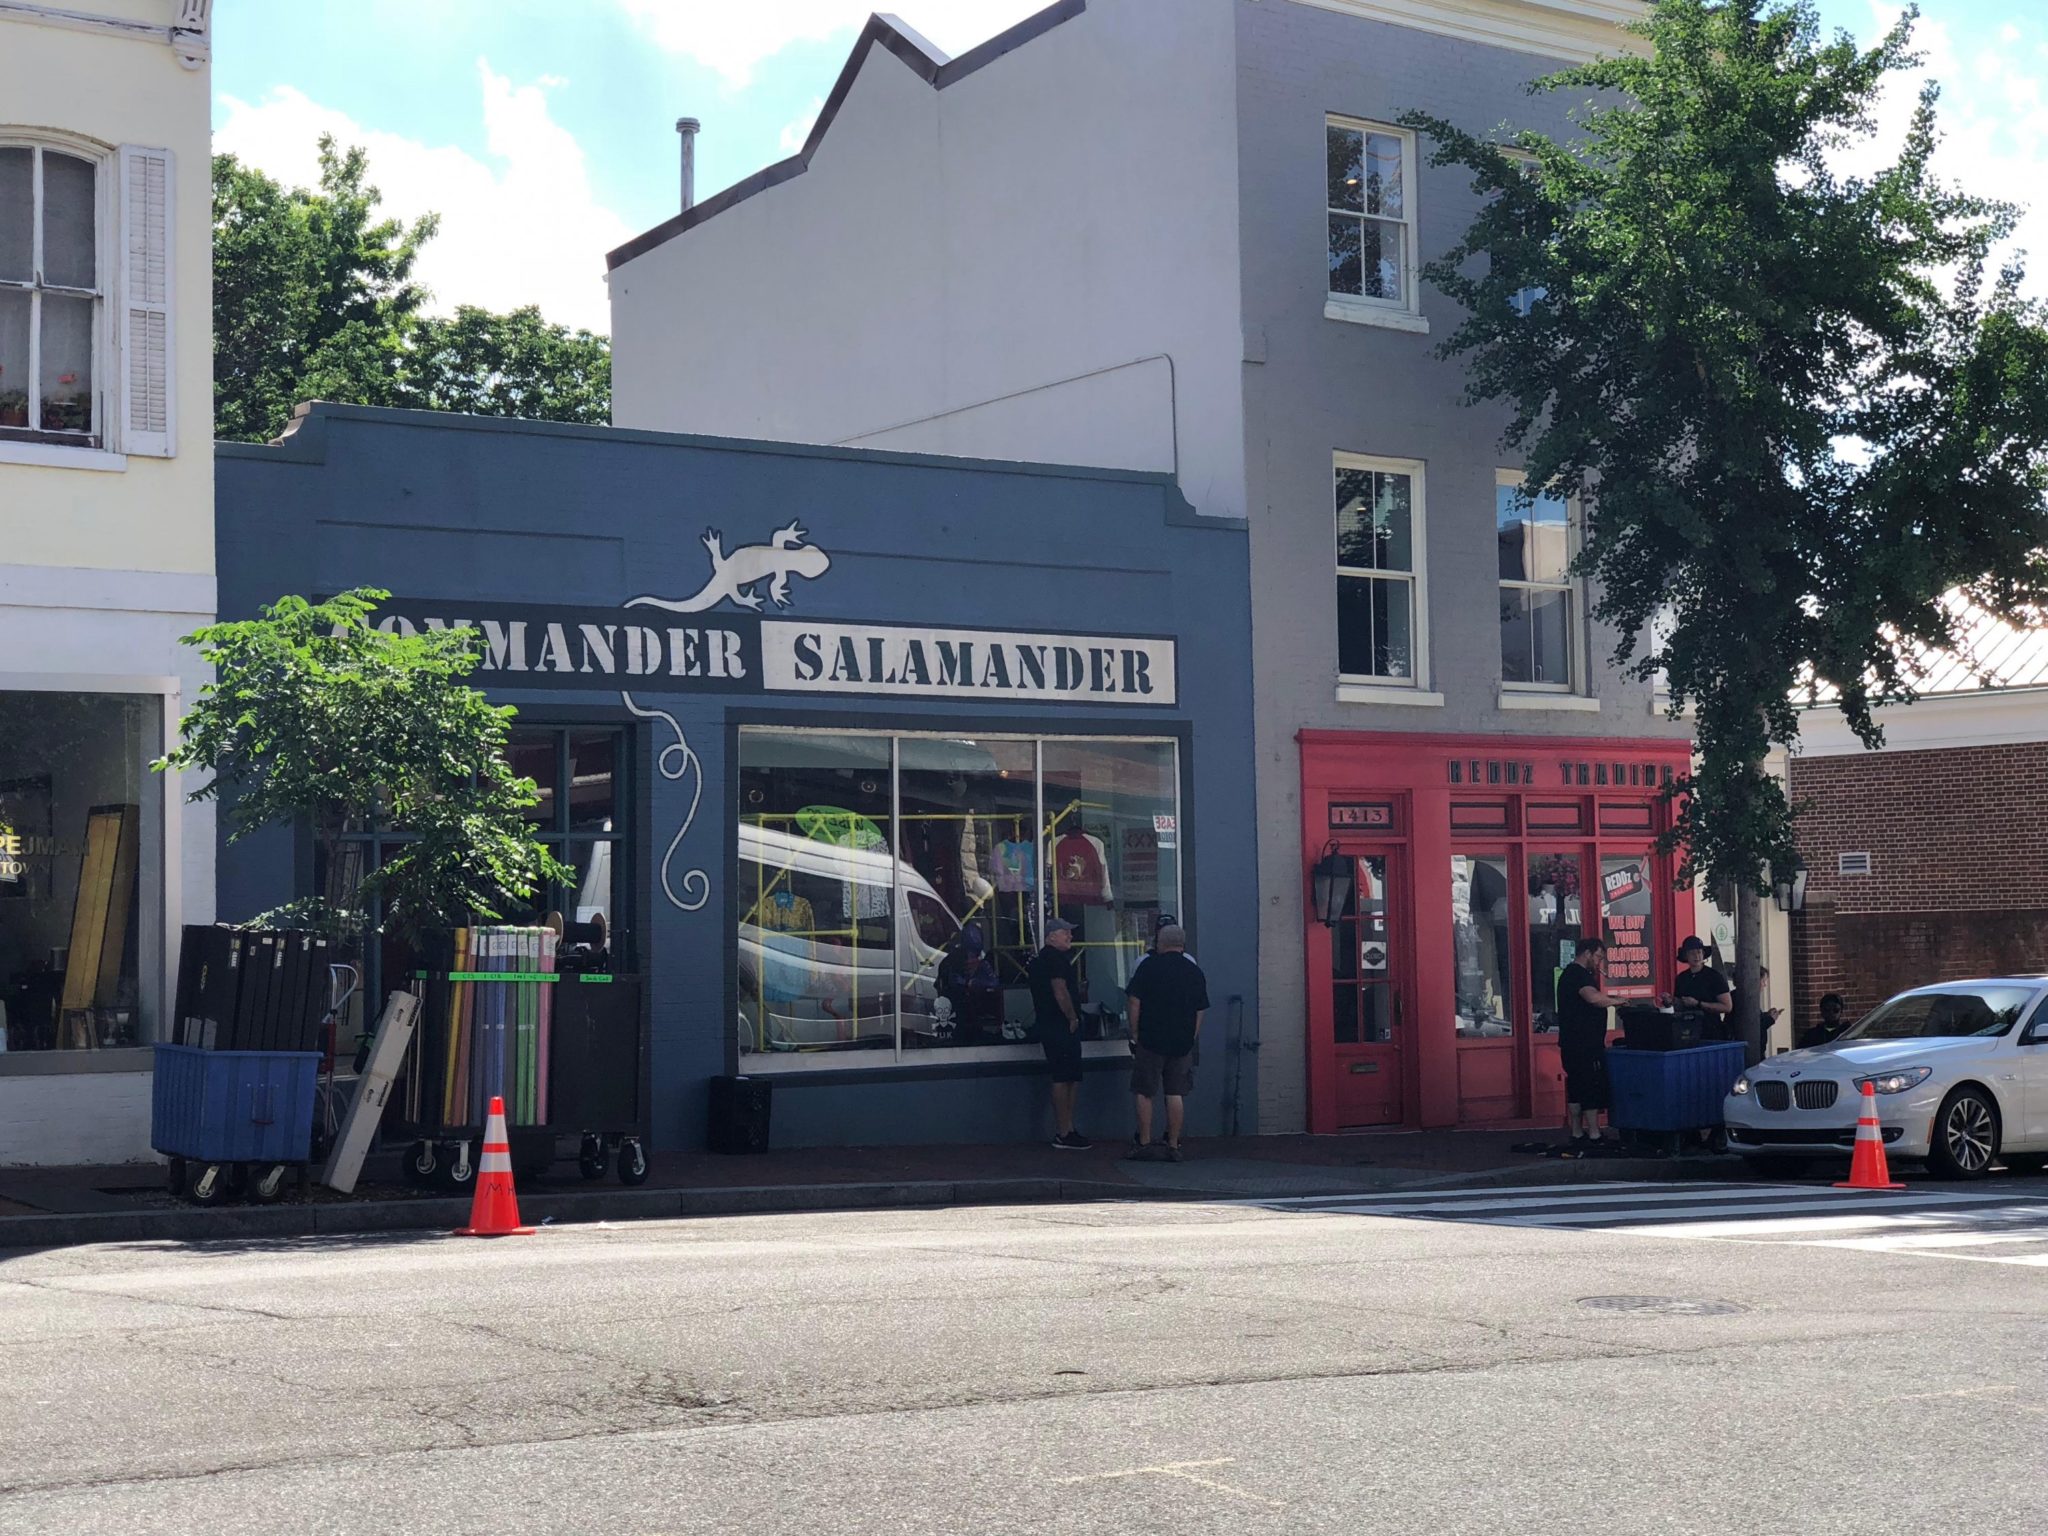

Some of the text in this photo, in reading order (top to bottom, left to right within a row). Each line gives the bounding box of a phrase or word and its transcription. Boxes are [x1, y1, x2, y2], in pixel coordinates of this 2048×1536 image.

[793, 632, 1154, 695] SALAMANDER
[1560, 762, 1674, 787] TRADING
[1338, 809, 1383, 822] 1413
[1608, 914, 1646, 930] WE BUY
[1614, 930, 1641, 945] YOUR
[1606, 946, 1650, 962] CLOTHES
[1607, 962, 1650, 978] FOR $$$
